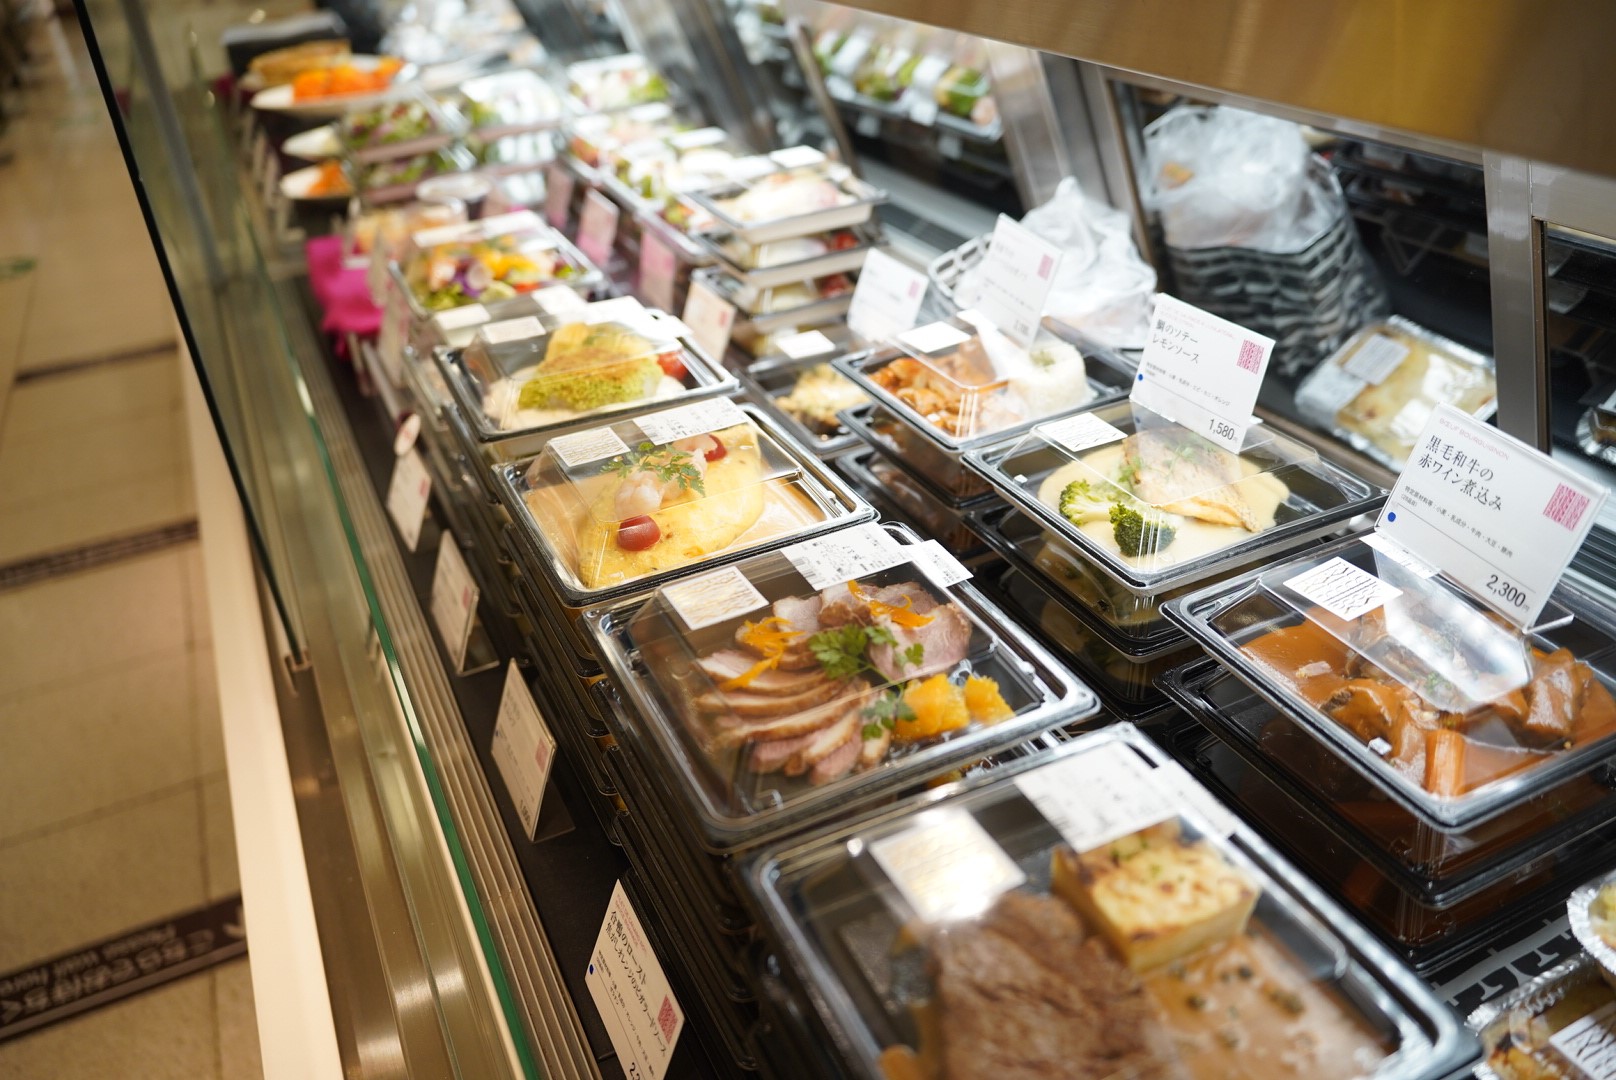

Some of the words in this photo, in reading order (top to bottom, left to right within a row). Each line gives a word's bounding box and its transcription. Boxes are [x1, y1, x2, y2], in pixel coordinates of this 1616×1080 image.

[1152, 334, 1199, 364] レモンソース
[1418, 453, 1502, 511] 赤ワイン煮込み
[1425, 434, 1494, 482] 黒毛和牛の
